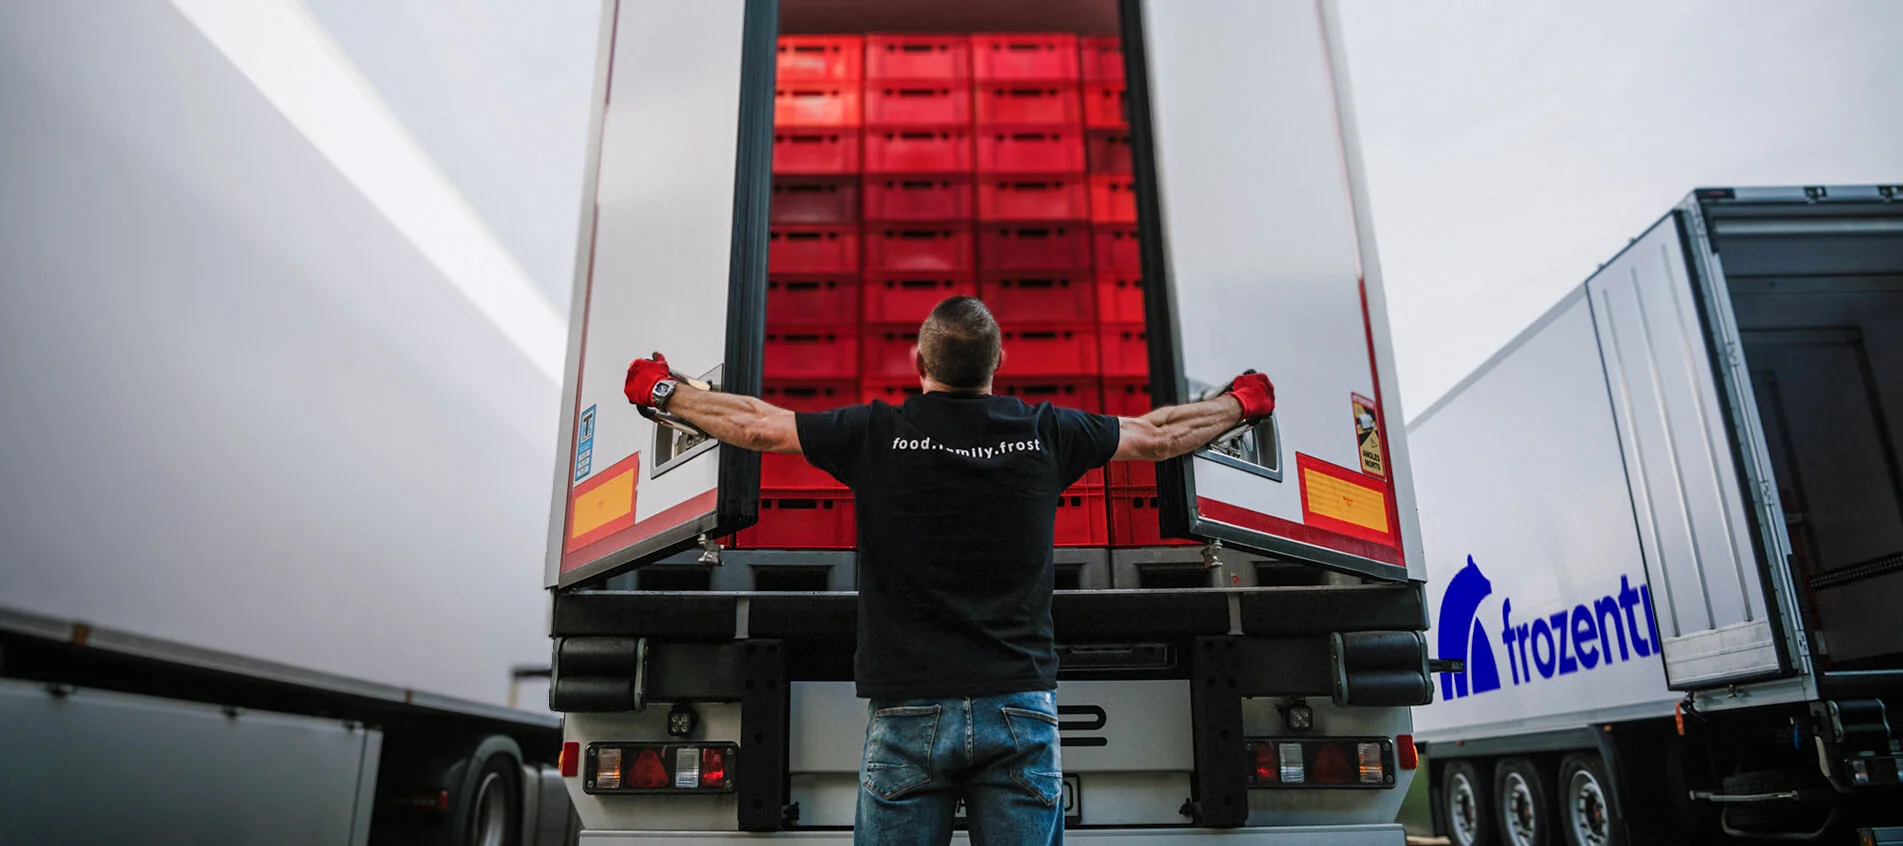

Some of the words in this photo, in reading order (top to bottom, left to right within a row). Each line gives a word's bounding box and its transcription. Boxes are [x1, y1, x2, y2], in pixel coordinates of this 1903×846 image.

[892, 437, 1040, 458] food.mily.frost
[1363, 450, 1380, 462] ANGLES
[1365, 459, 1380, 471] MORTS
